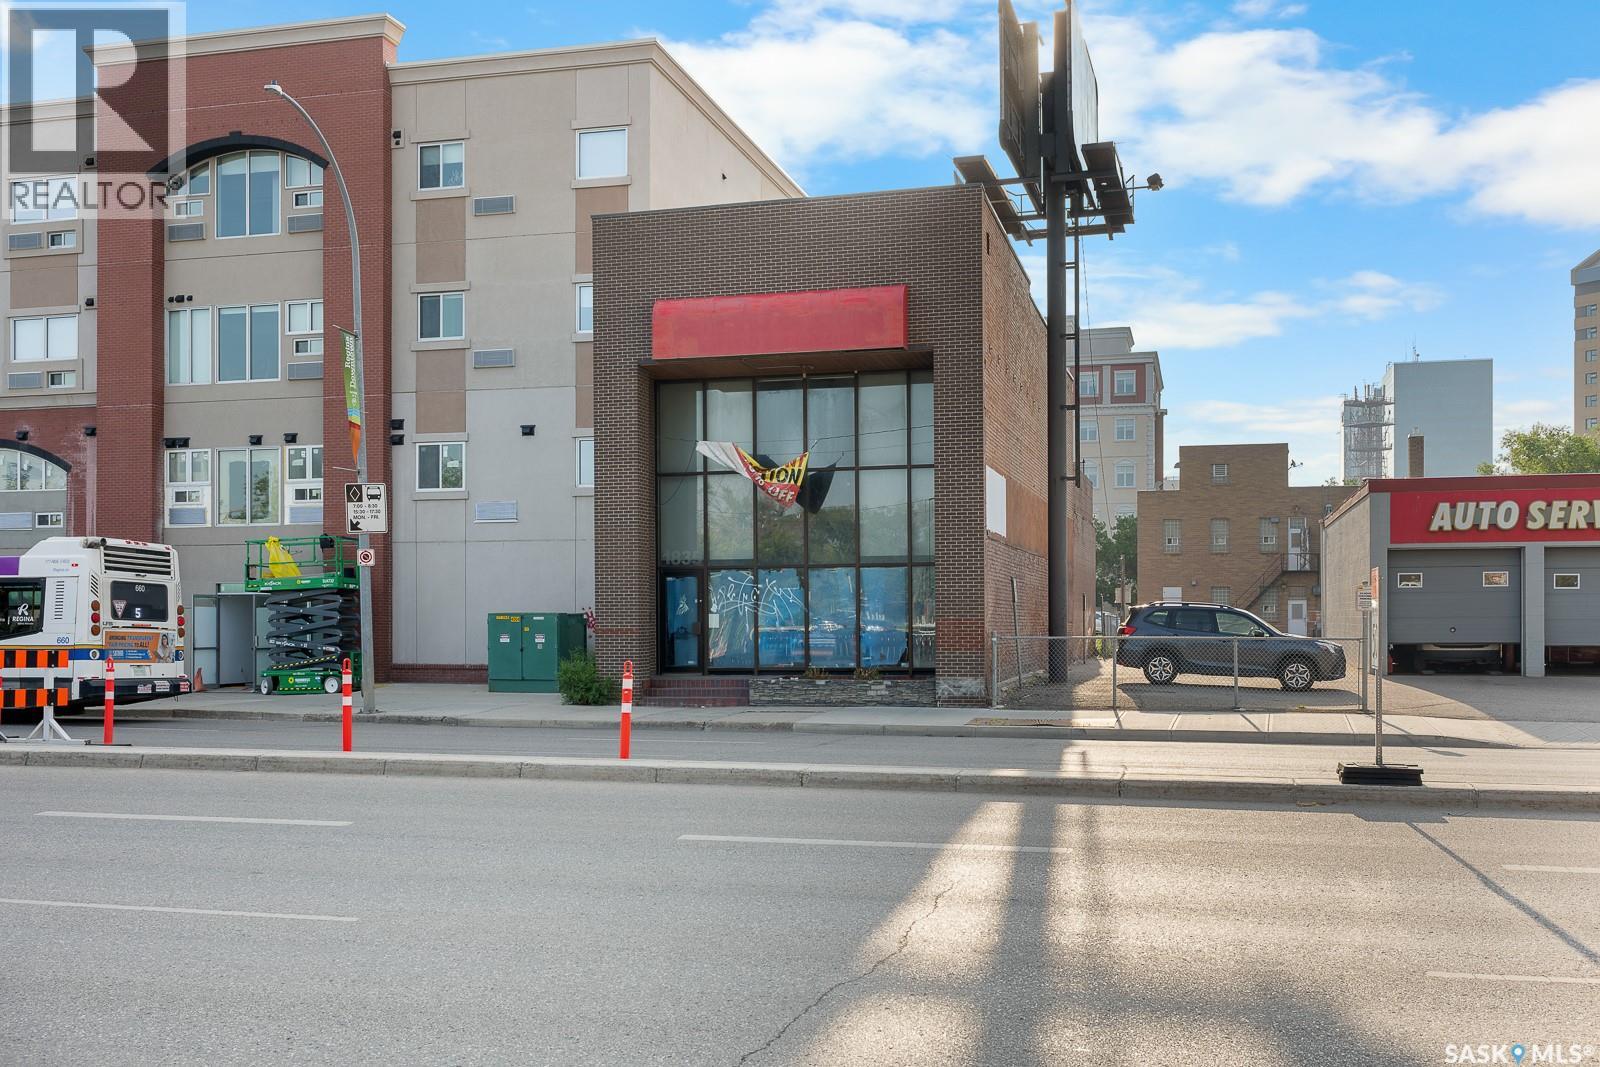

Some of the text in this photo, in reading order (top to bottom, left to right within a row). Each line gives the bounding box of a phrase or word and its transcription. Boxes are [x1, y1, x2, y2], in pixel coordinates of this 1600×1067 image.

[349, 335, 357, 389] Downtown
[768, 487, 795, 502] OFF
[1429, 501, 1520, 531] AUTO
[134, 584, 146, 592] 660
[135, 607, 142, 619] 5
[56, 636, 70, 644] 660
